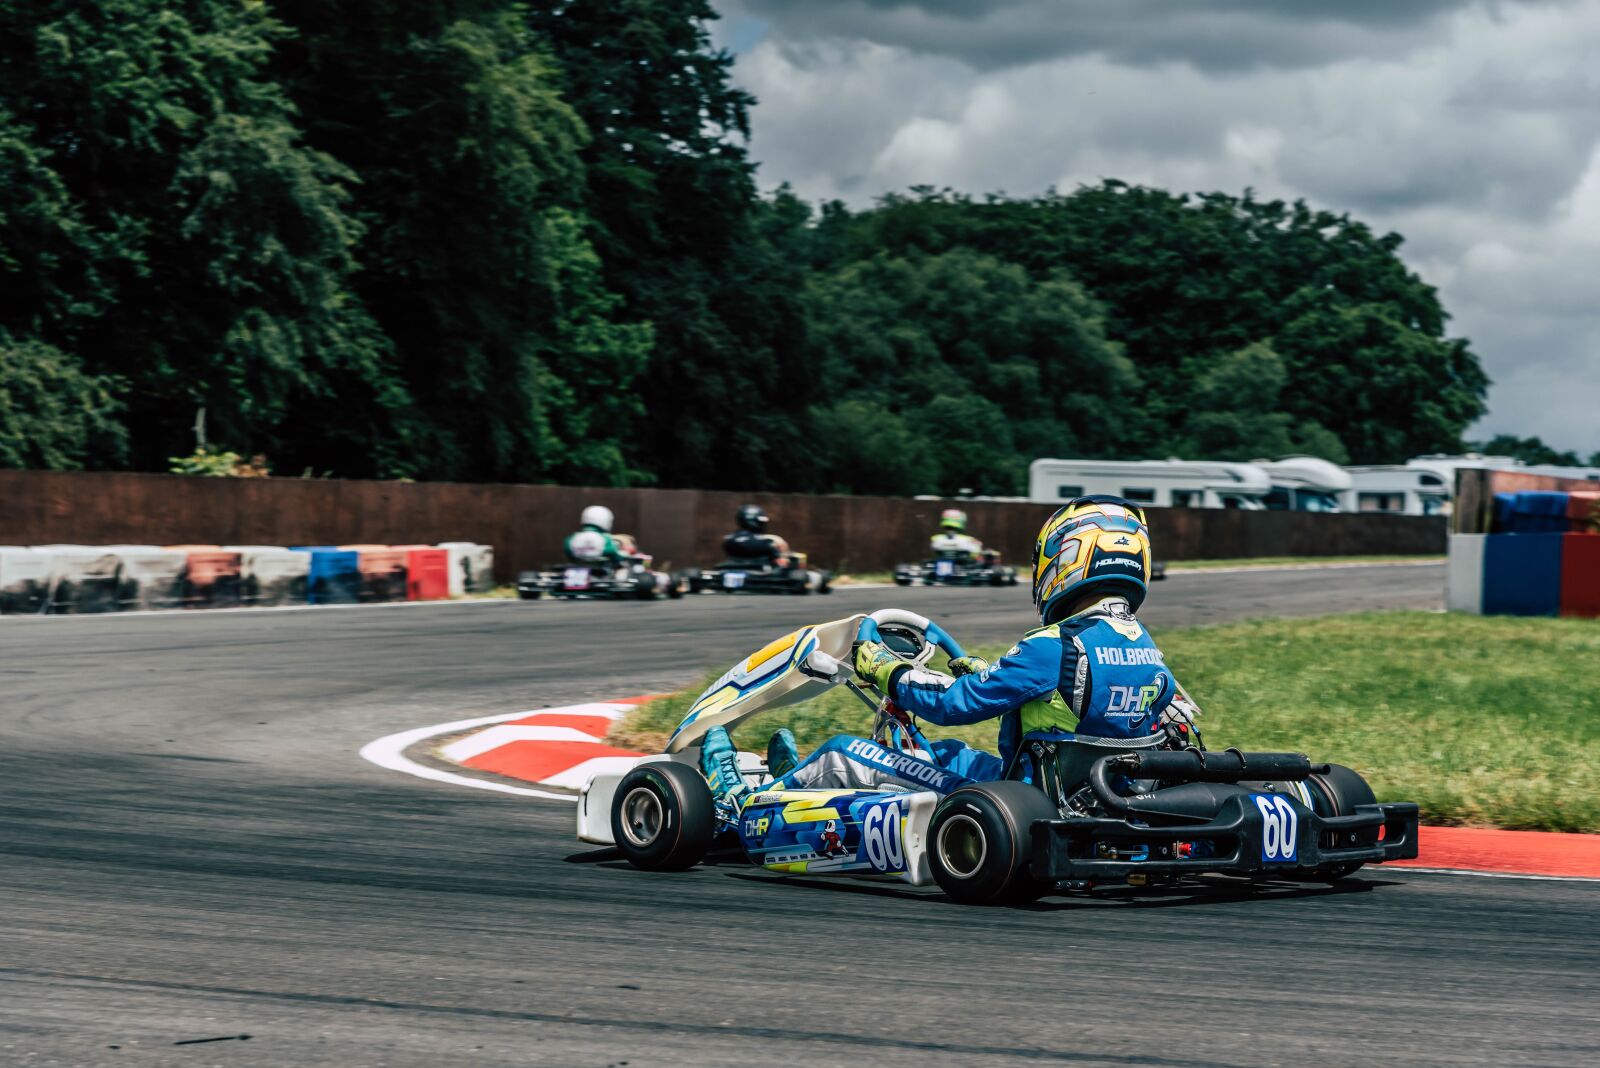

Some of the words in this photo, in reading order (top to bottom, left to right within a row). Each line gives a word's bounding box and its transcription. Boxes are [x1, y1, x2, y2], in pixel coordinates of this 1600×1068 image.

[1094, 557, 1142, 571] HOLBROOK
[1094, 646, 1165, 667] HOLBROO
[1106, 685, 1159, 712] DHR
[847, 738, 949, 788] HOLBROOK
[745, 817, 769, 837] DHR
[864, 801, 904, 871] 60
[1255, 795, 1298, 859] 60
